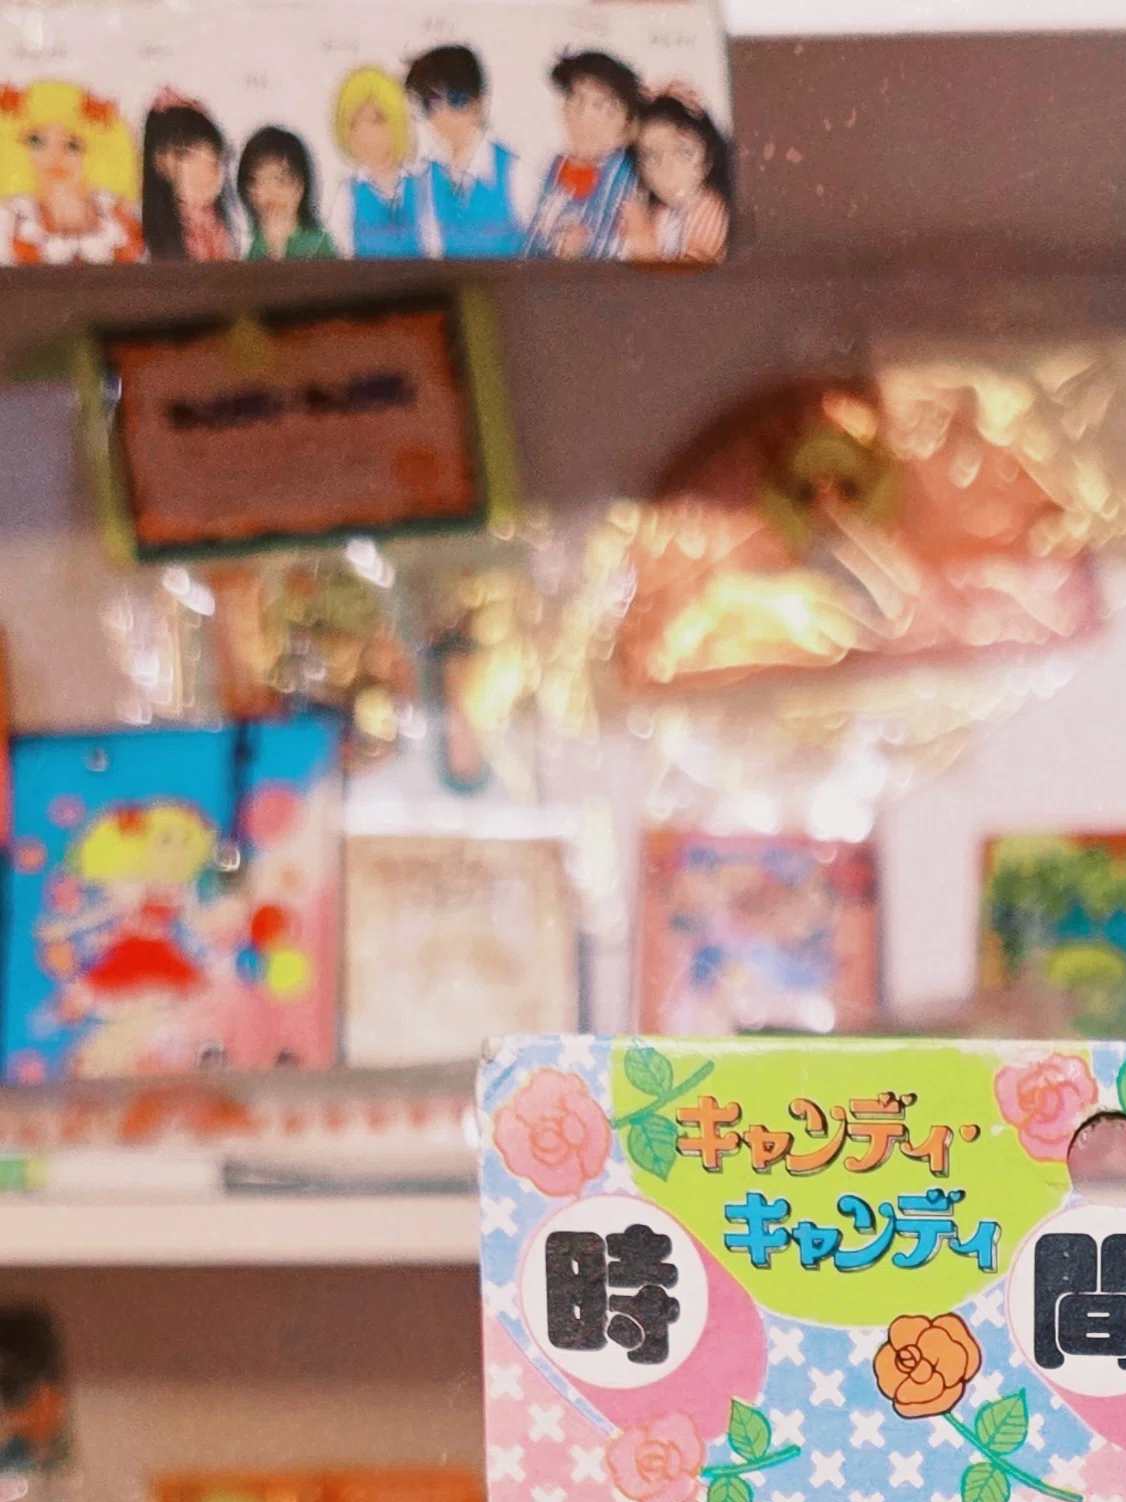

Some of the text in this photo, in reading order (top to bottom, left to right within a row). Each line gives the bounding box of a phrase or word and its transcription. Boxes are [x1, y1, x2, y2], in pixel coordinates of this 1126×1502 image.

[723, 1189, 1000, 1273] キャンディ
[545, 1223, 680, 1365] 時
